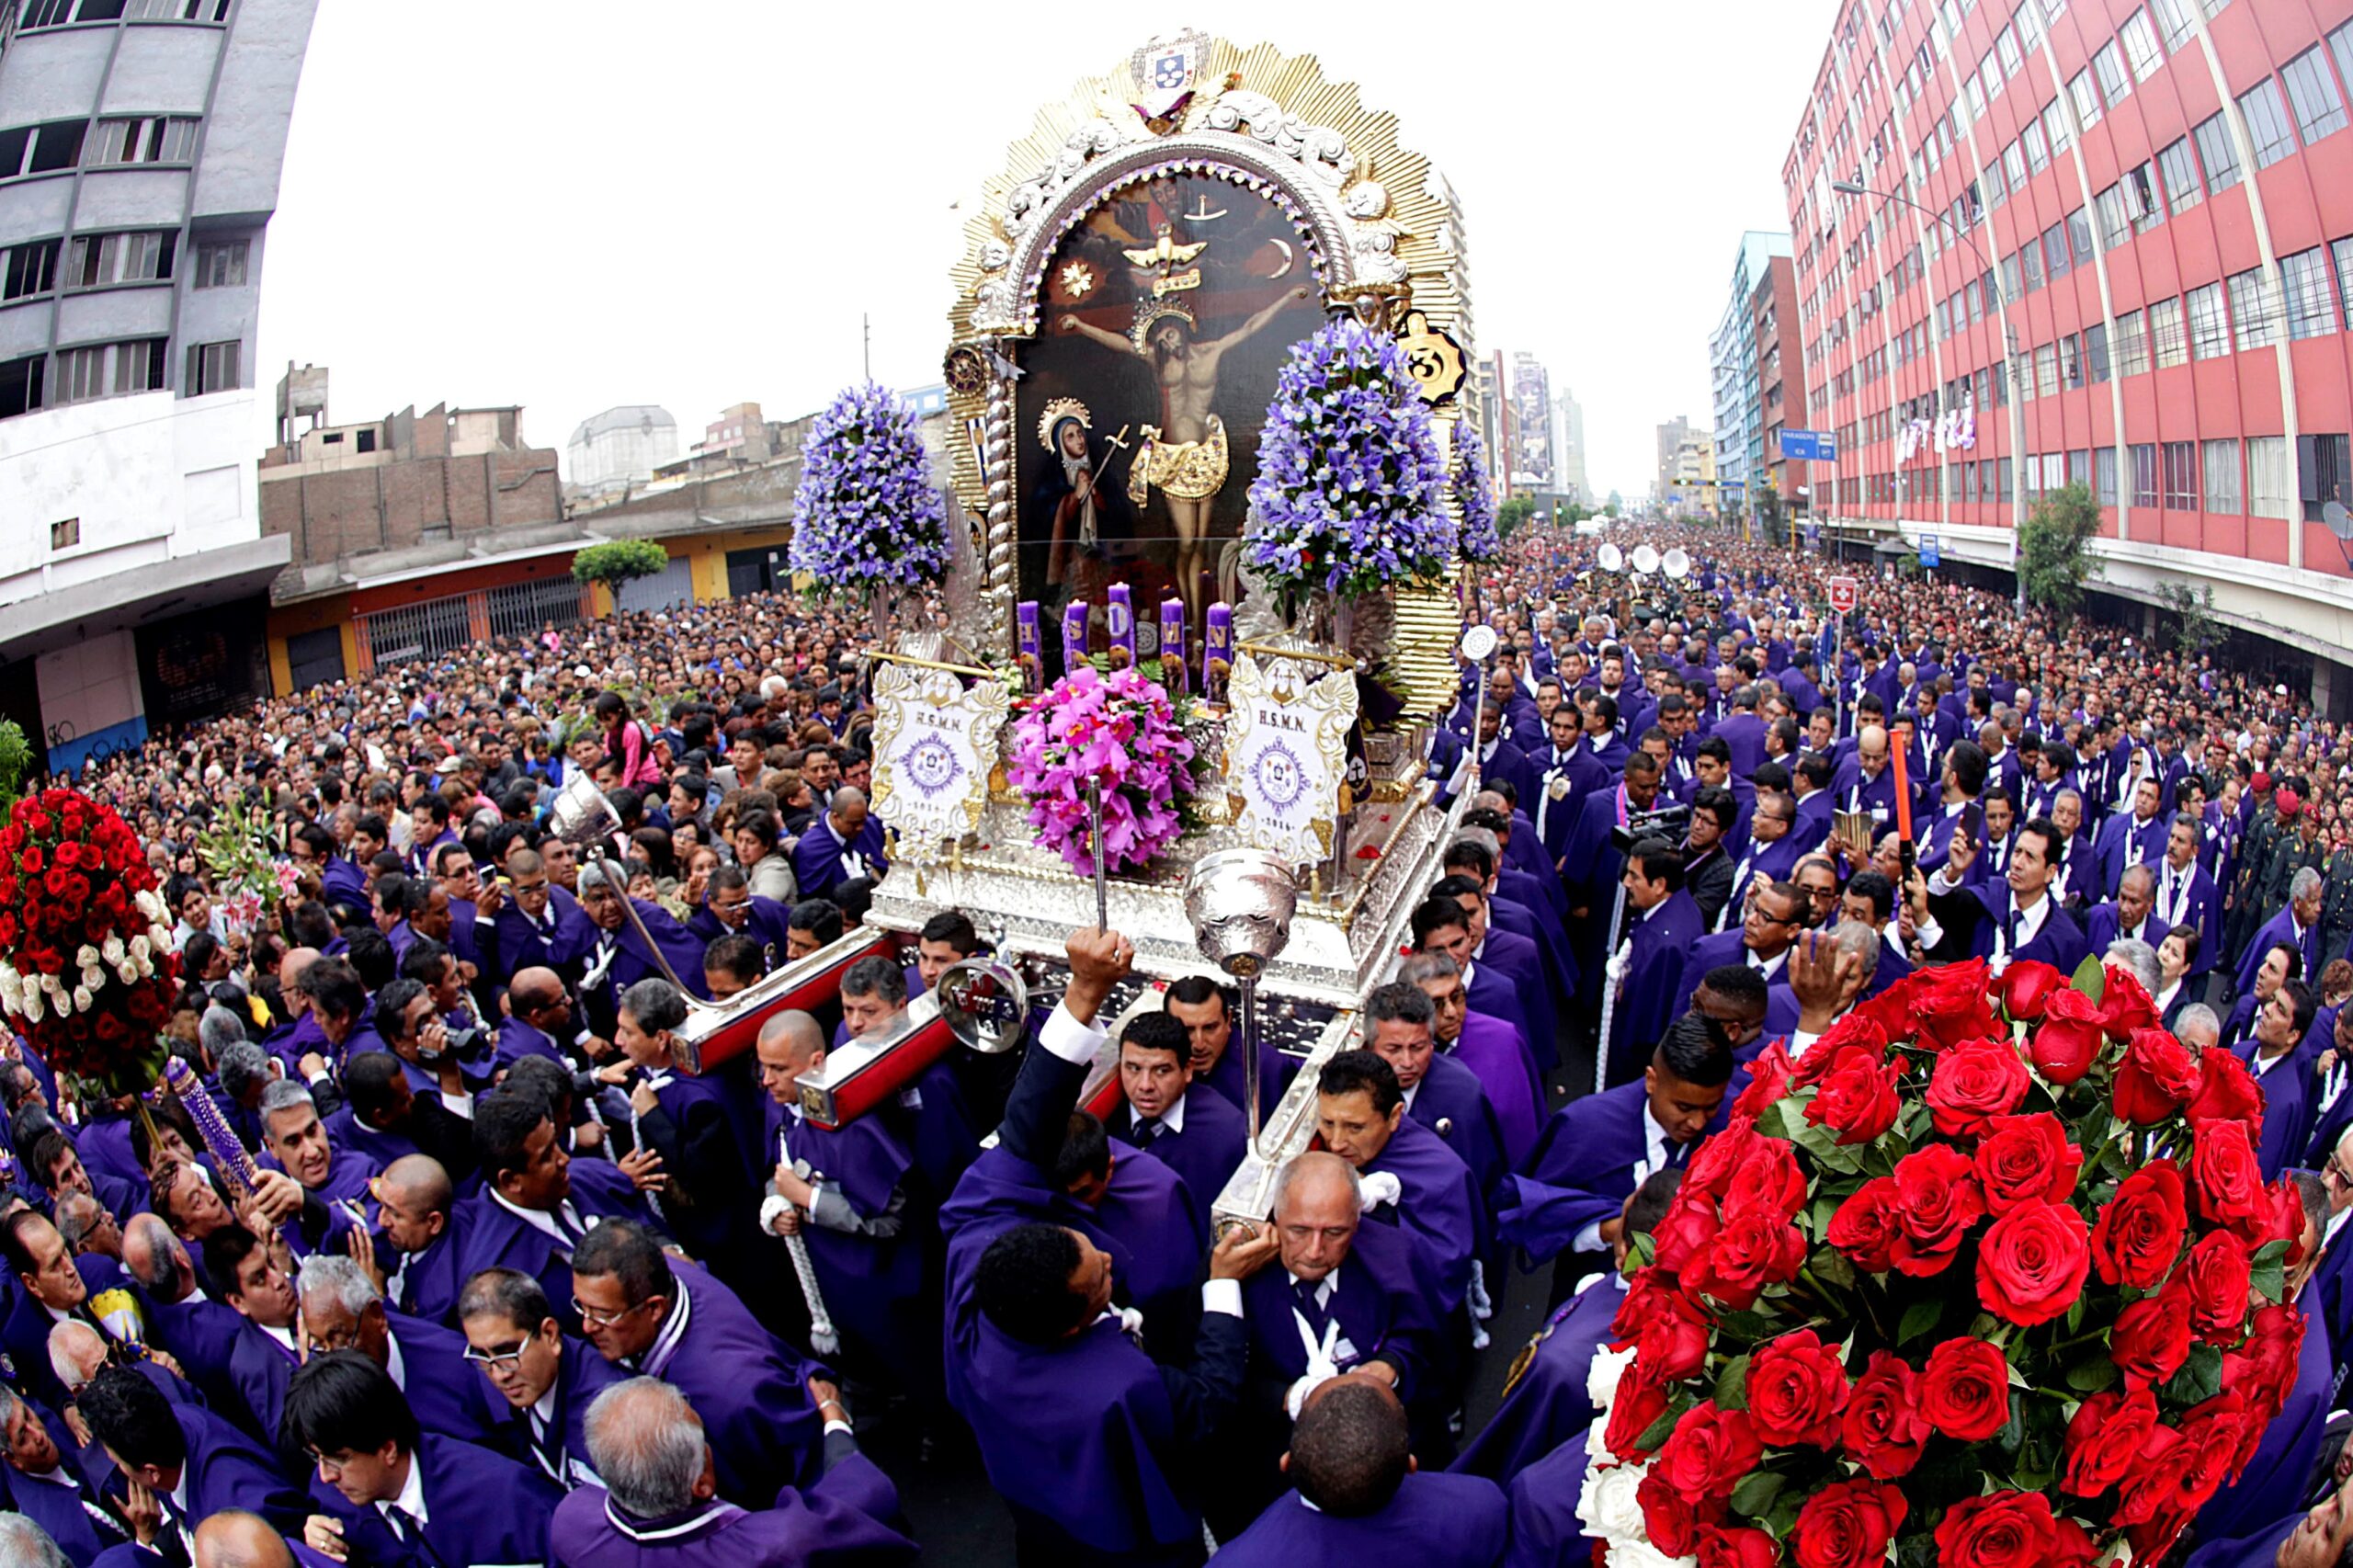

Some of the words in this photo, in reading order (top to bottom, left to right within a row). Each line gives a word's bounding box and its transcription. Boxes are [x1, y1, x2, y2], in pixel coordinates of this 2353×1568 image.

[1017, 621, 1035, 643] H
[1068, 619, 1082, 641] S
[1162, 620, 1180, 644] M
[1208, 625, 1227, 649] N
[1259, 710, 1307, 733] H.S.M.N.
